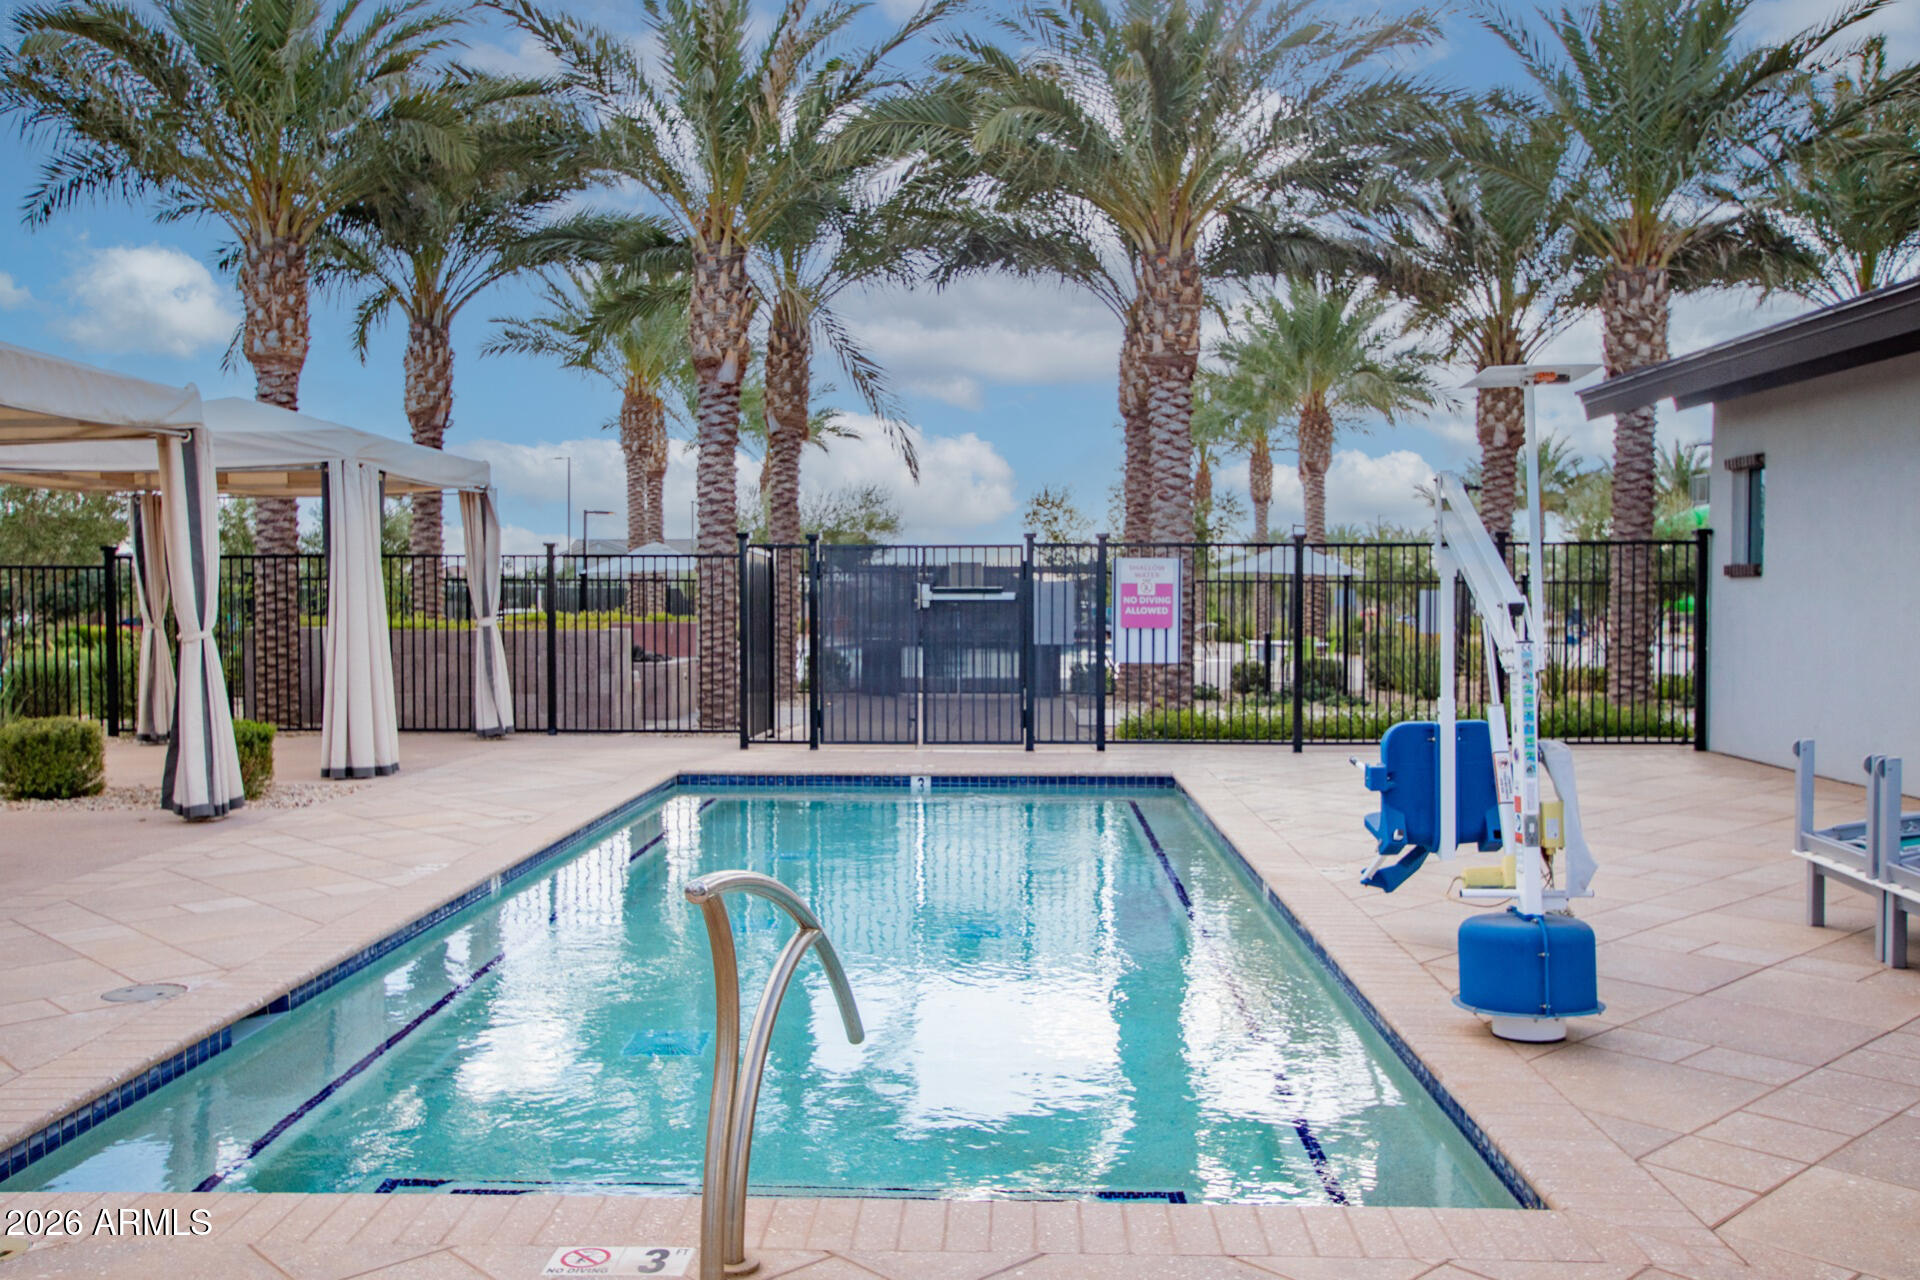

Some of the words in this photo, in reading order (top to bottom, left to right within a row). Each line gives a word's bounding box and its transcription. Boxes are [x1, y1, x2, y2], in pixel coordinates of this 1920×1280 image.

[1123, 596, 1137, 604] NO
[1139, 596, 1171, 604] DIVING
[1125, 606, 1169, 615] ALLOWED
[638, 1248, 671, 1274] 3
[675, 1248, 690, 1256] FT
